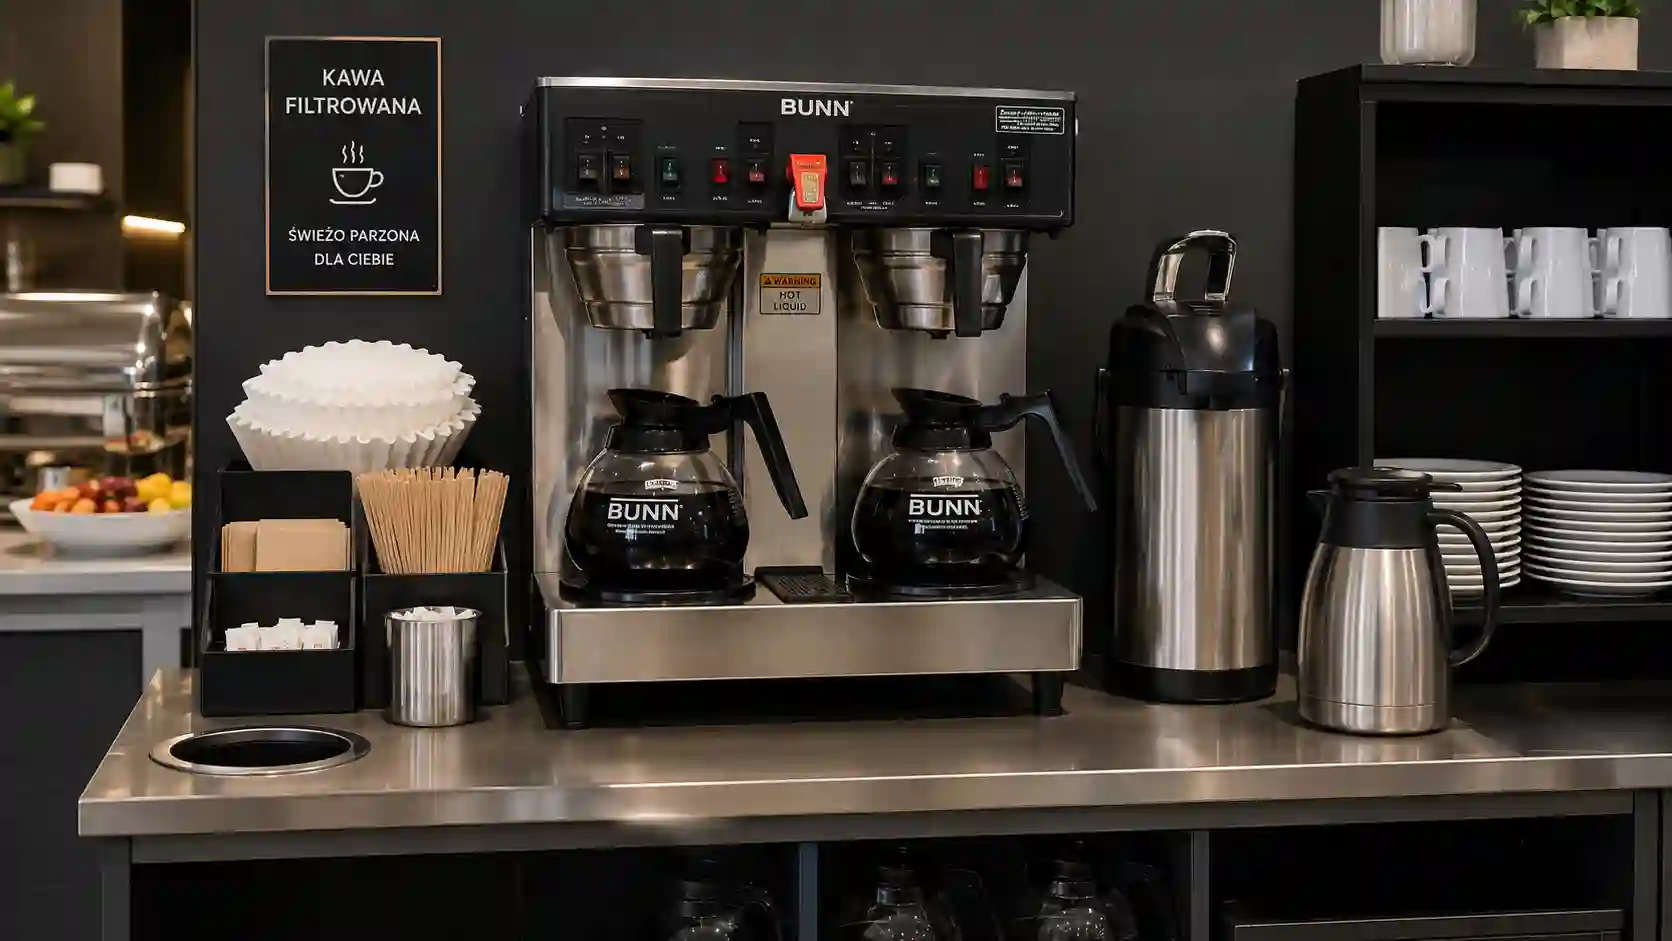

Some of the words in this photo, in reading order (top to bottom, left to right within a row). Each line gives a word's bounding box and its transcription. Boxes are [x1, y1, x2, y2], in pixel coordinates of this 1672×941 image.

[322, 68, 385, 87] KAWA
[285, 96, 422, 115] FILTROWANA
[781, 98, 850, 117] BUNN
[350, 229, 420, 242] PARZONA
[314, 252, 344, 266] DLA
[347, 252, 395, 266] CIEBIE
[774, 277, 817, 285] WARNING
[779, 290, 801, 300] HOT
[773, 302, 807, 311] LIQUID
[607, 502, 679, 521] BUNN
[908, 498, 981, 516] BUNN
